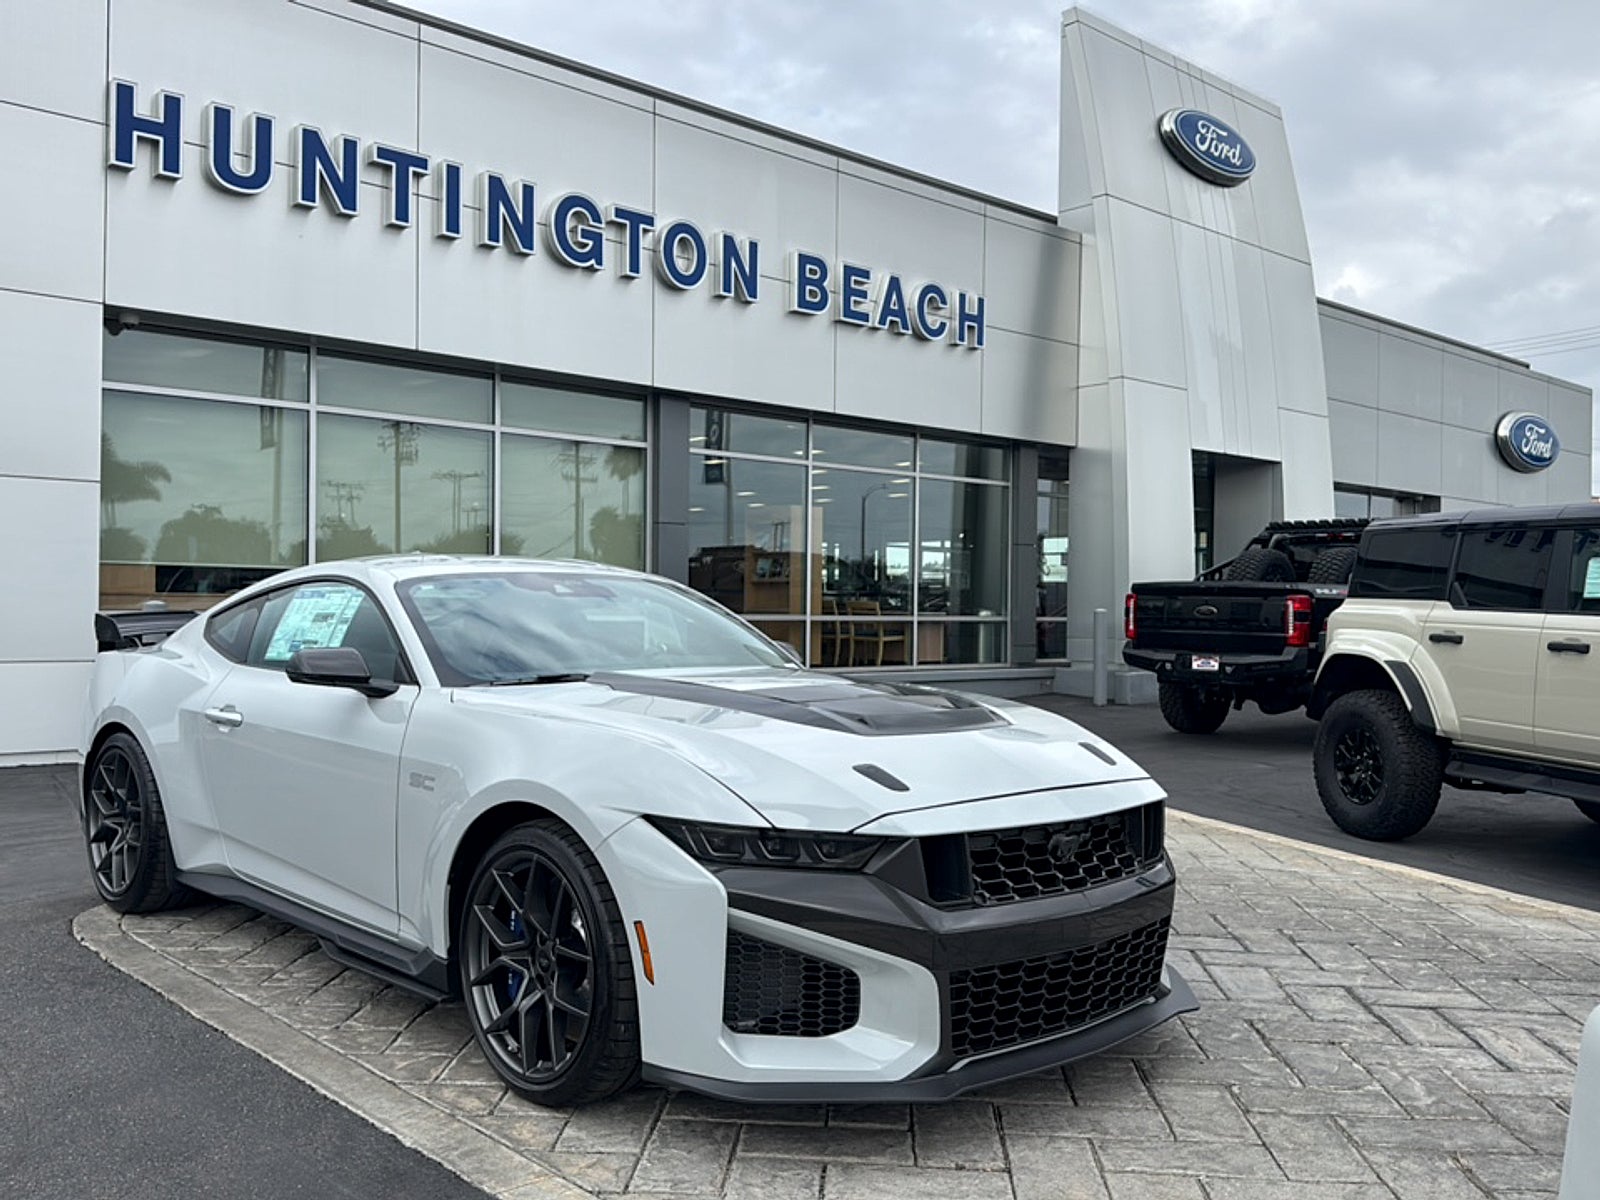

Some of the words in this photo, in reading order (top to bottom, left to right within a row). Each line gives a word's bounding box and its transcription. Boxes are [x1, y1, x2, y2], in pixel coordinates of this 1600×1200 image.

[1195, 120, 1243, 166] Ford
[110, 79, 760, 303] HUNTINGTON
[791, 249, 985, 350] BEACH
[1522, 423, 1553, 459] Ford
